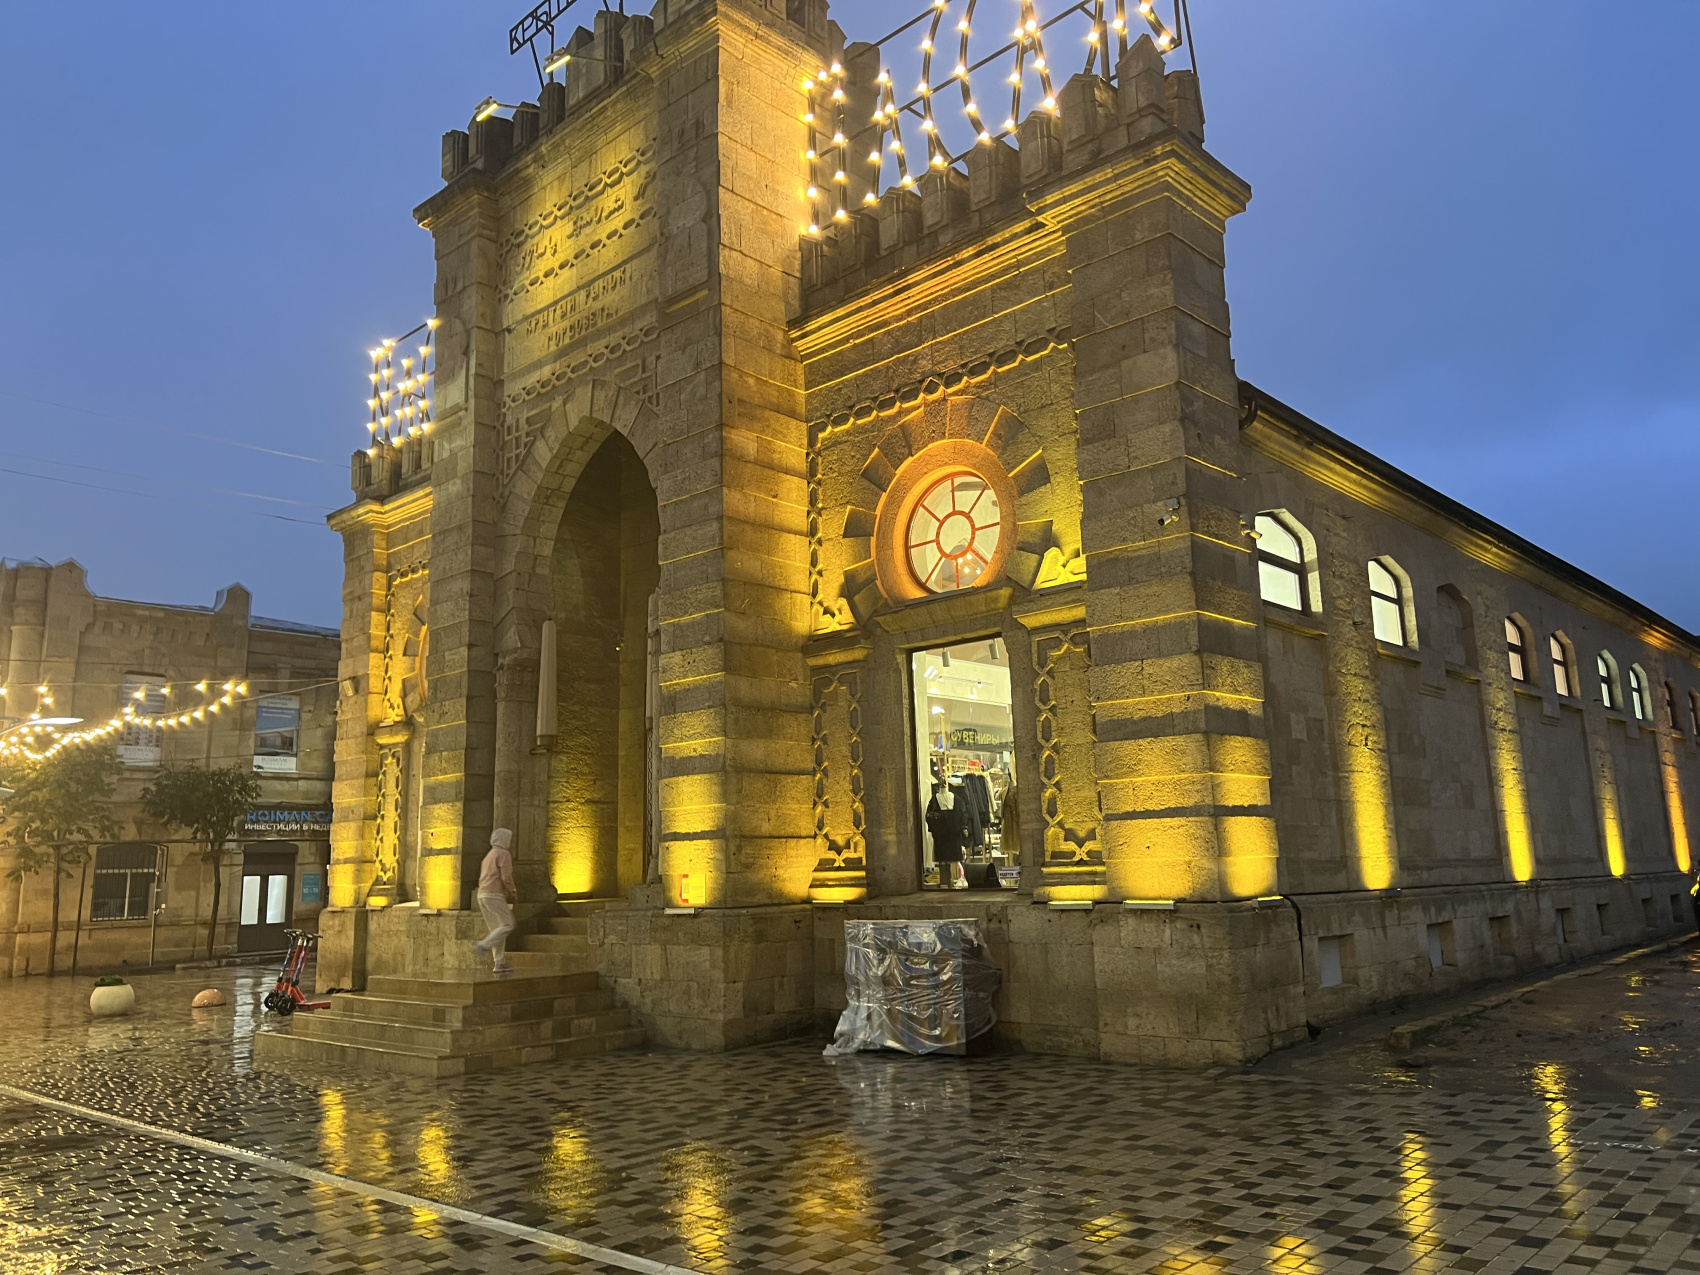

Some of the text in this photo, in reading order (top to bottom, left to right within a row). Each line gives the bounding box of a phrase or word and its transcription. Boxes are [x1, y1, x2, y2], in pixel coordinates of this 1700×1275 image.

[583, 265, 628, 307] РЫНОК
[950, 730, 1000, 747] СУВЕНИРЫ
[246, 810, 311, 822] ROIMAN
[245, 823, 300, 831] ИНВЕСТИЦИИ
